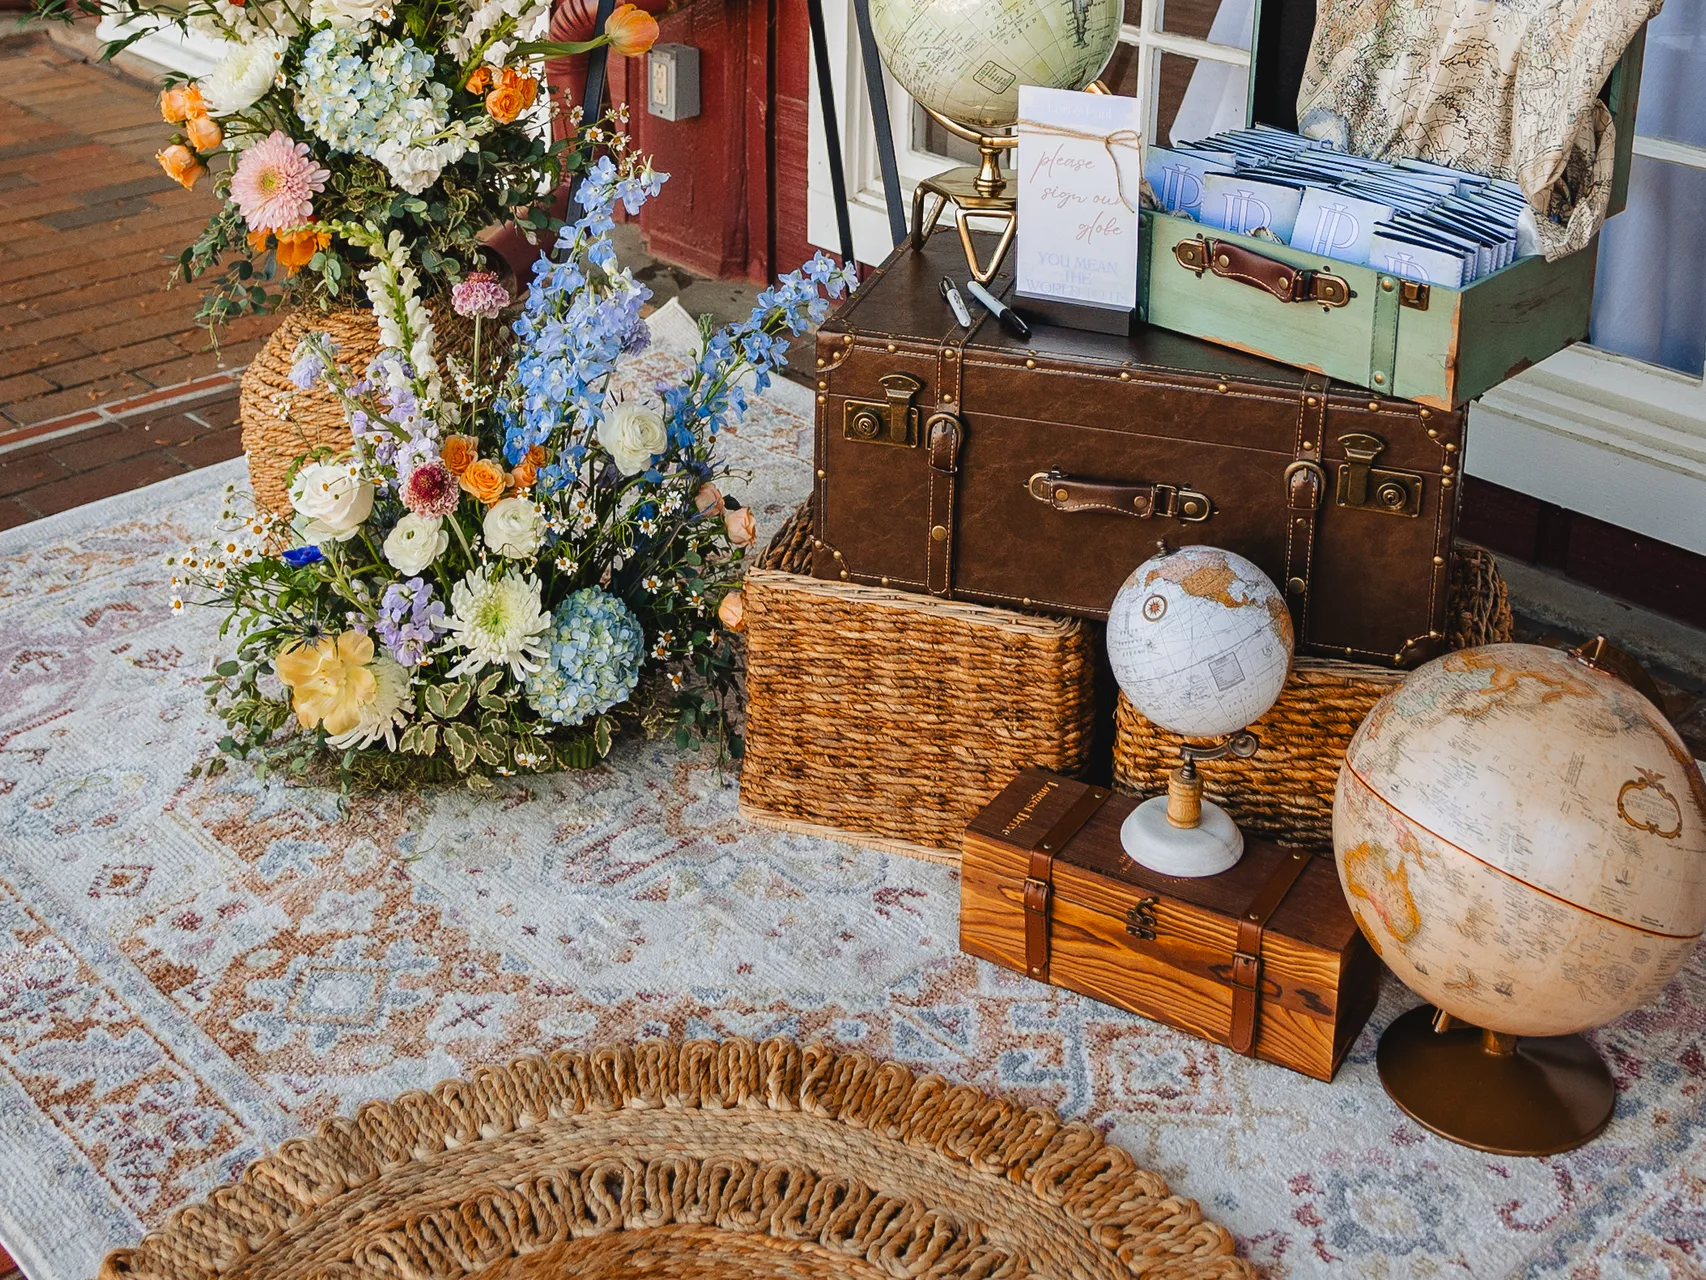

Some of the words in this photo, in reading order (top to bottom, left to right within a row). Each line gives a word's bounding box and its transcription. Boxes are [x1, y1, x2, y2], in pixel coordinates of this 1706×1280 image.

[1030, 143, 1096, 184] please
[1040, 186, 1088, 209] sign
[1075, 211, 1124, 245] globe
[1037, 251, 1071, 268] YOU
[1074, 256, 1119, 275] MEAN
[1064, 269, 1092, 285] THE
[1024, 781, 1059, 812] Longest
[1001, 812, 1032, 836] Drive
